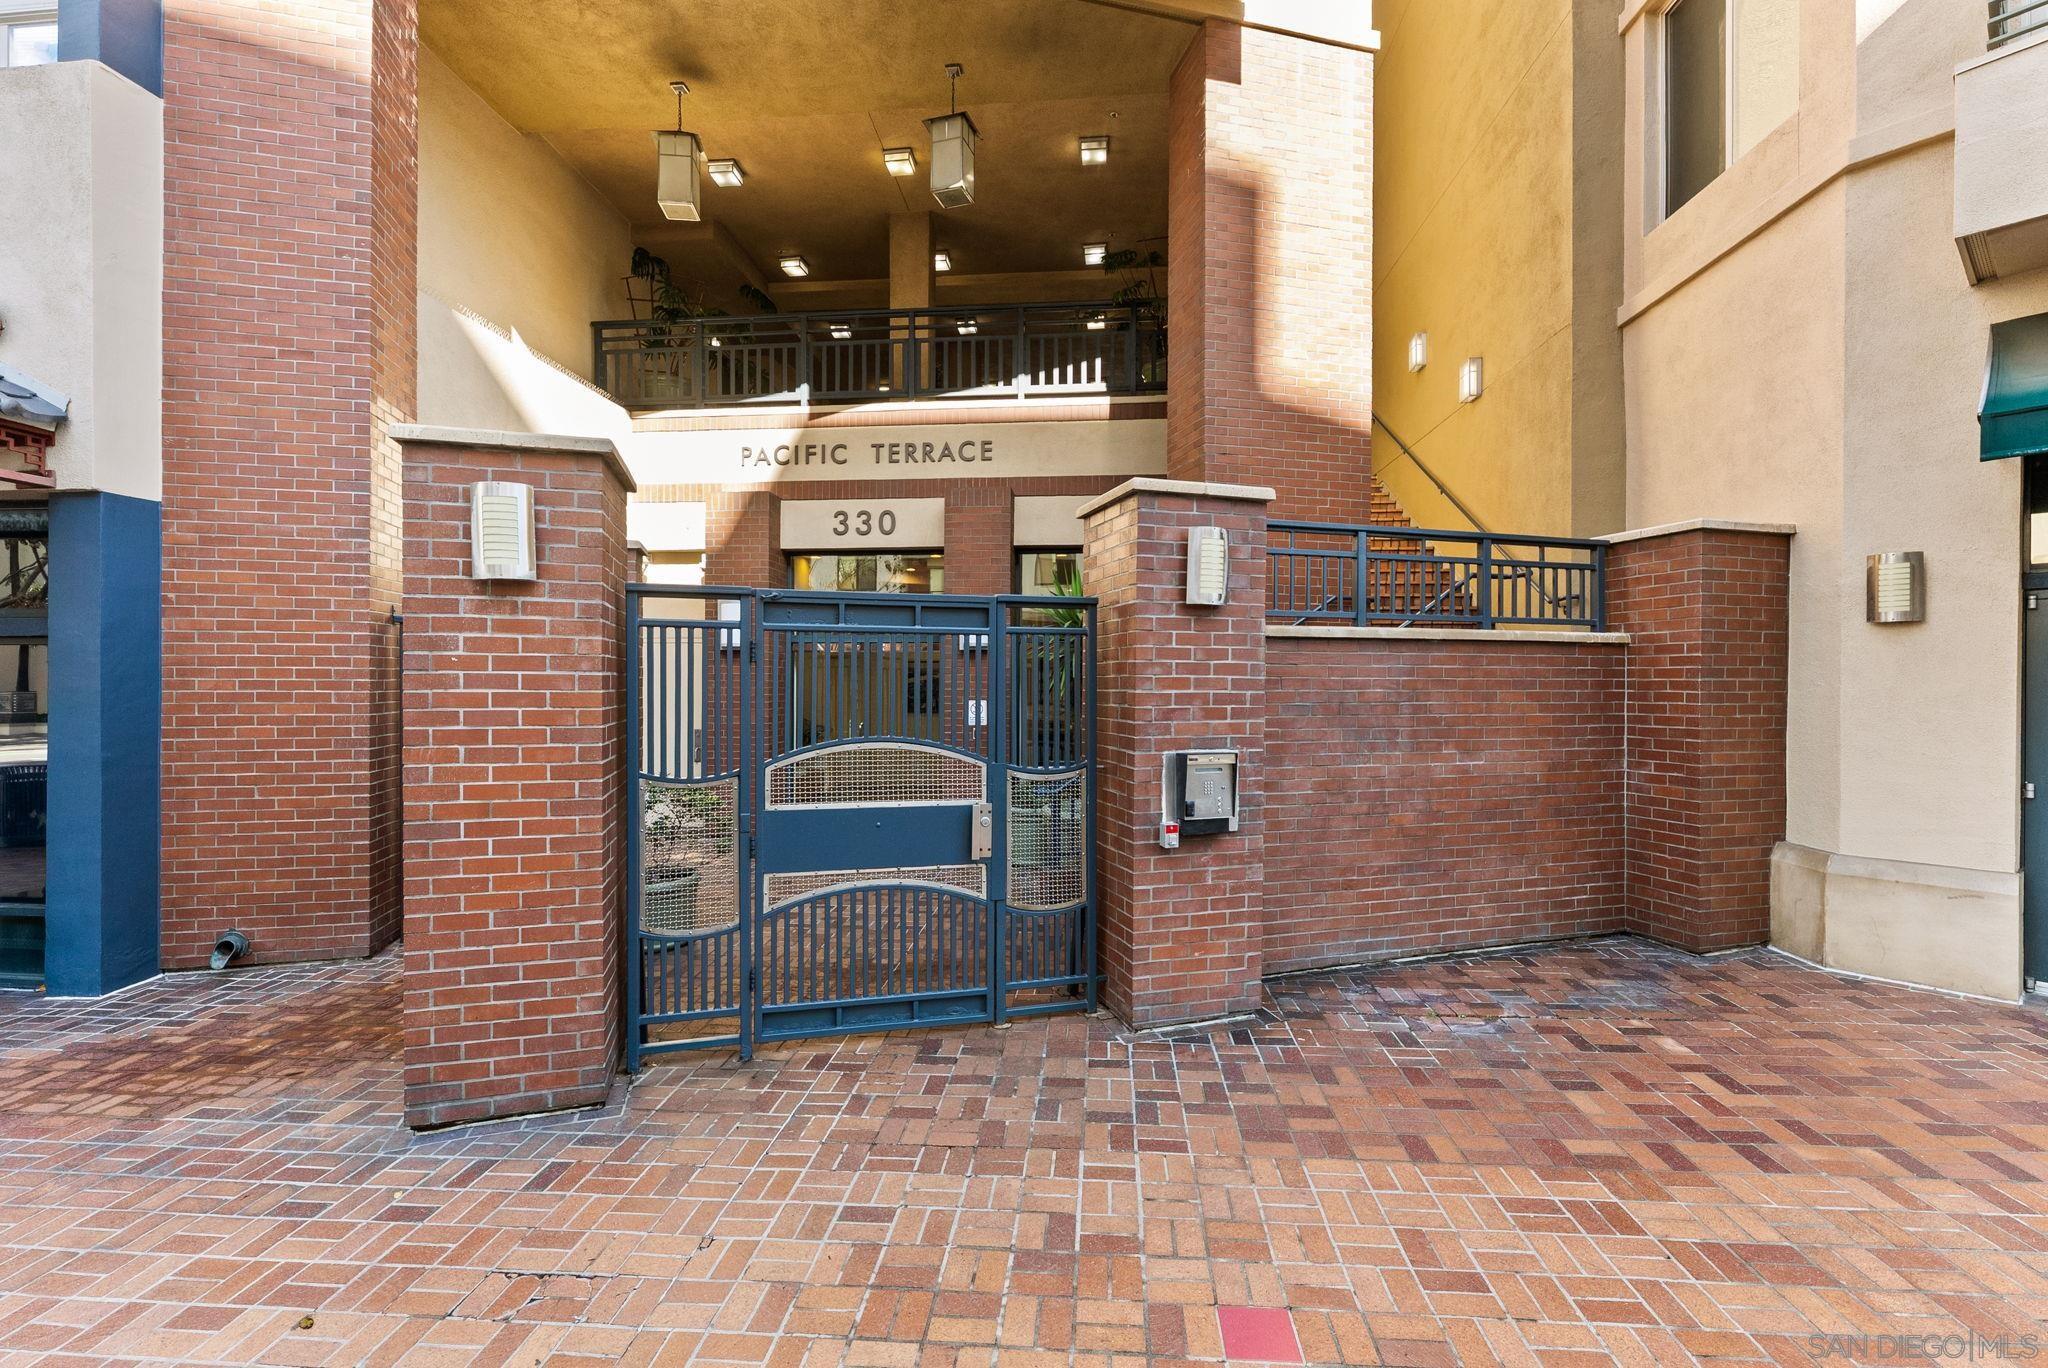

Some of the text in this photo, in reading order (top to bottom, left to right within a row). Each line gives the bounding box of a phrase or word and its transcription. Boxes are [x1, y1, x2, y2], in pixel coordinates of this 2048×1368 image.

[741, 440, 993, 467] PACIFIC TERRACE
[833, 510, 897, 537] 330
